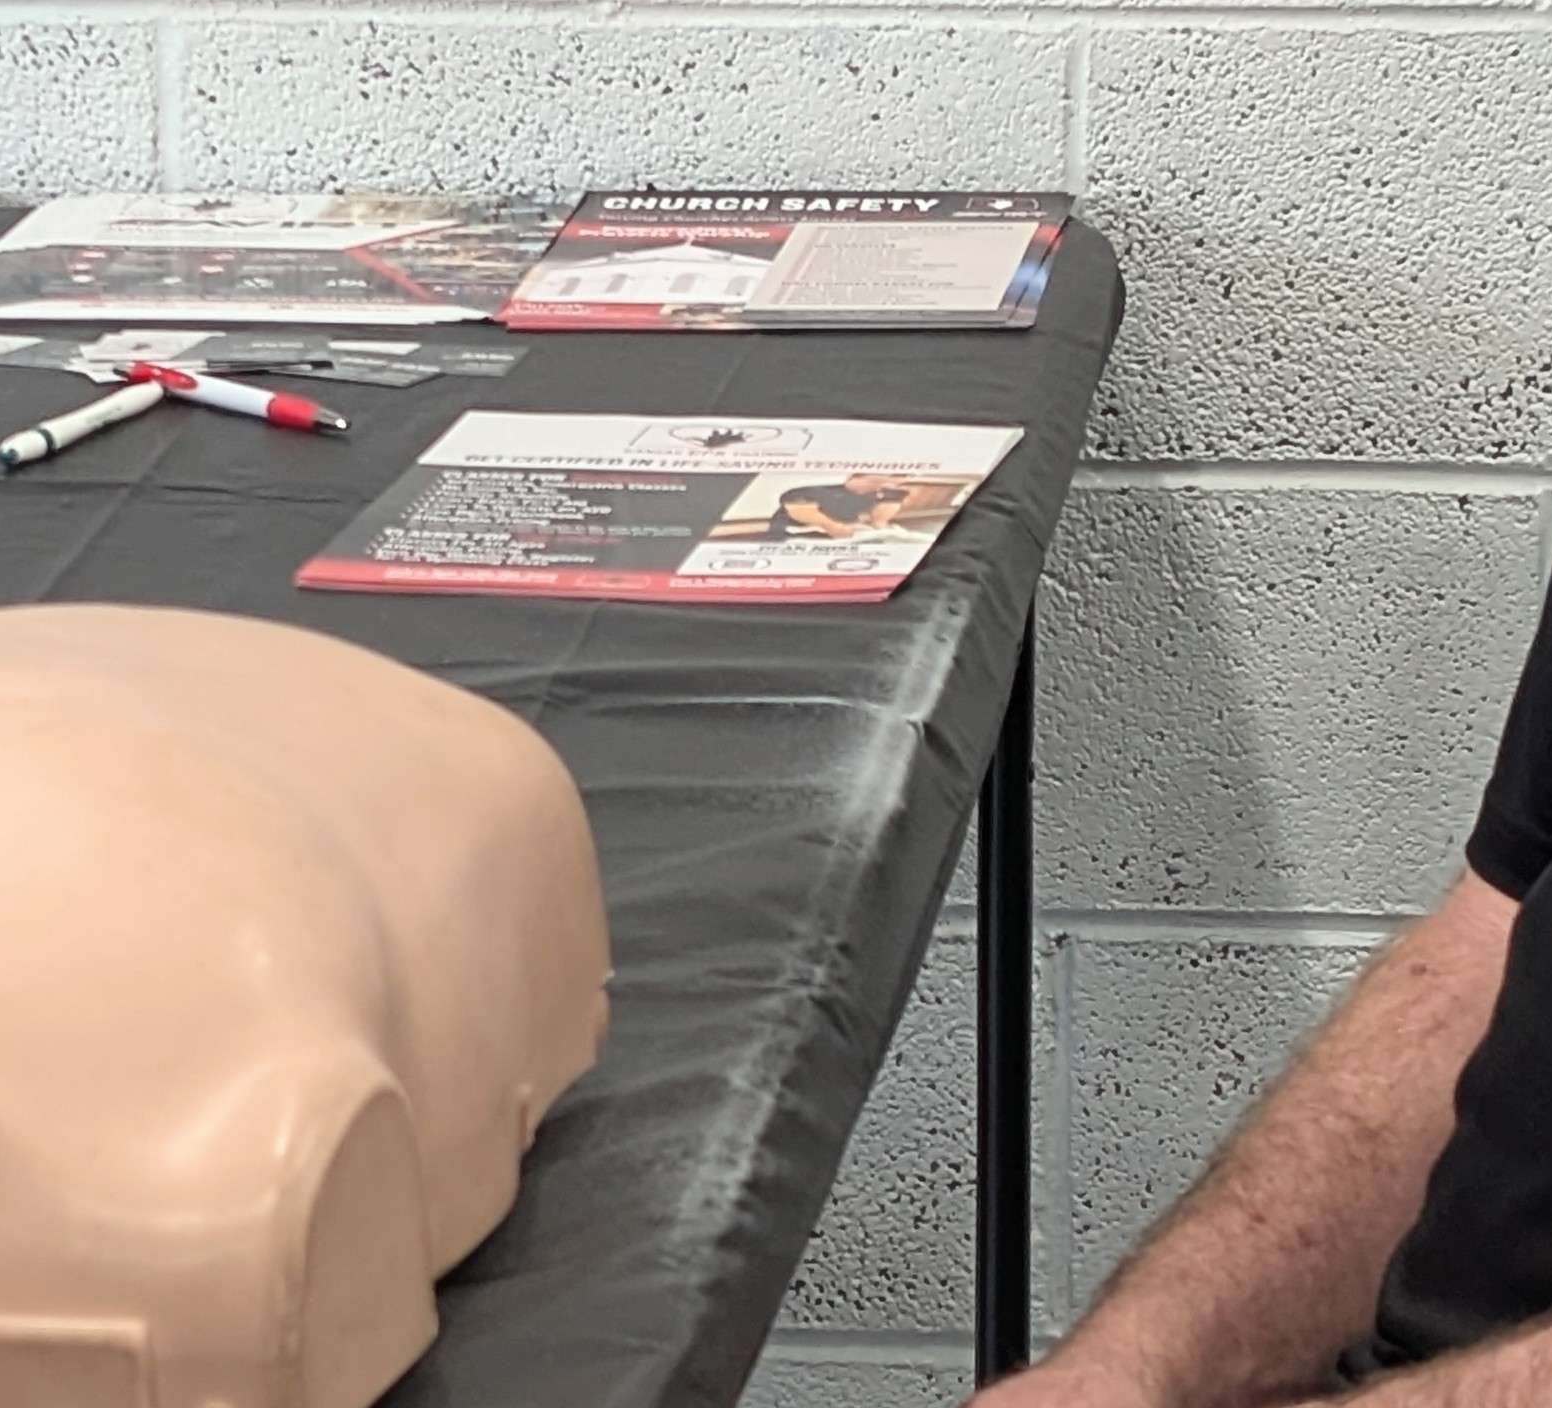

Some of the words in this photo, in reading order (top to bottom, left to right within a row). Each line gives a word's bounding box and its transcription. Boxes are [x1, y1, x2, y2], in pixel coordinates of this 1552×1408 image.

[603, 196, 770, 211] CHURCH
[780, 197, 940, 212] SAFETY
[511, 455, 623, 465] CERTIFIED
[629, 458, 654, 467] IN
[803, 460, 943, 470] TECHNIQUES
